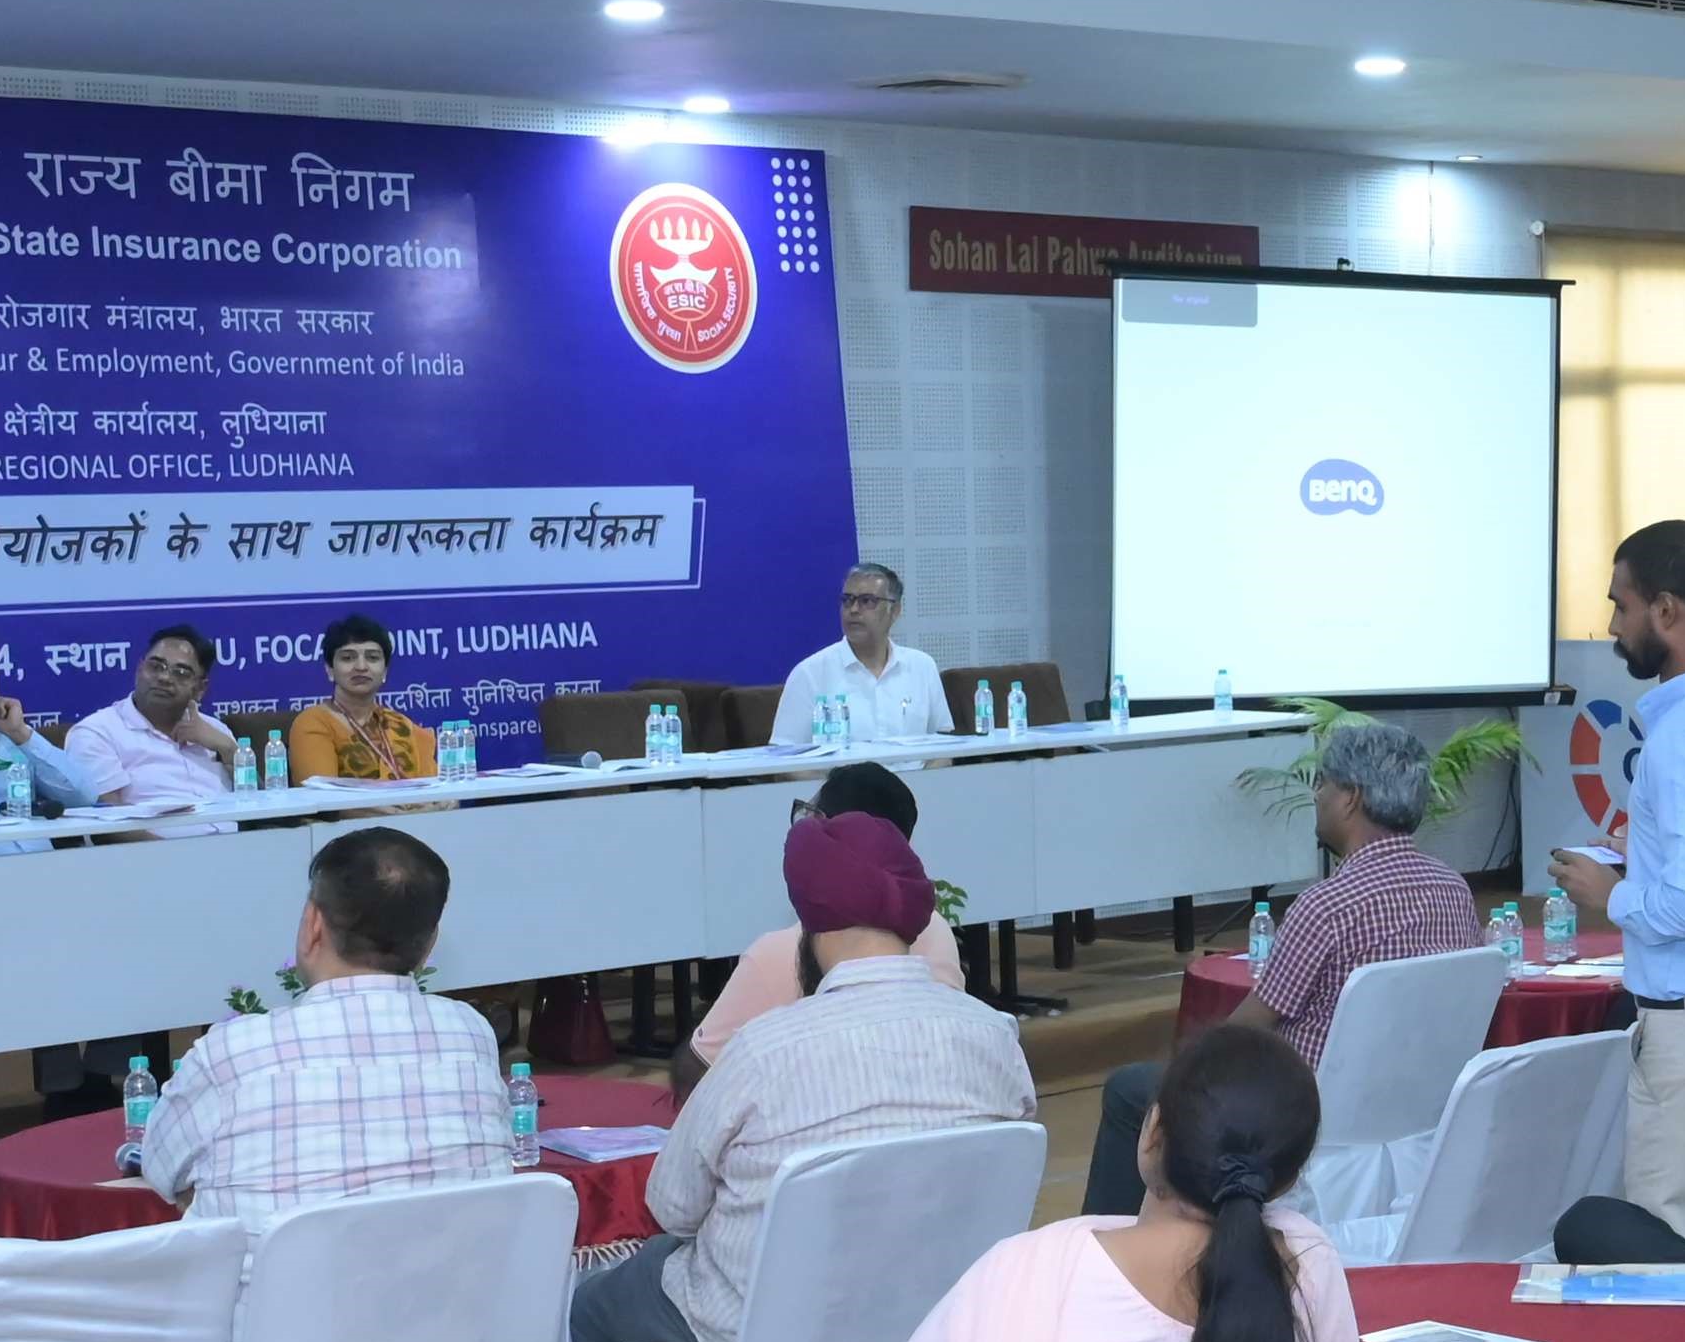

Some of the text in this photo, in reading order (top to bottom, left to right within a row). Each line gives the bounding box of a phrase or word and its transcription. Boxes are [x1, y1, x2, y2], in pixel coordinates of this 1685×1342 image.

[23, 151, 142, 199] राज्य
[166, 147, 267, 205] बीमा
[290, 152, 415, 212] निगम
[91, 225, 262, 263] Insurance
[272, 233, 463, 273] Corporation
[928, 228, 999, 273] Sohan
[1006, 234, 1040, 274] Lal
[105, 295, 205, 335] मंत्रालय,
[219, 305, 284, 335] भारत
[296, 308, 375, 336] सरकार
[667, 293, 707, 309] ESIC
[697, 266, 738, 343] SOCIAL SECURITY
[28, 347, 49, 373] &
[56, 347, 221, 379] Employment,
[228, 350, 377, 377] Government
[382, 351, 407, 376] of
[411, 352, 465, 377] India
[2, 402, 79, 436] क्षेत्रीय
[92, 400, 207, 441] कार्यालय,
[219, 402, 328, 449] लुधियाना
[127, 453, 223, 483] OFFICE,
[228, 452, 355, 478] LUDHIANA
[1309, 479, 1378, 507] BenQ
[165, 511, 210, 560] के
[228, 518, 312, 560] साथ
[327, 513, 512, 557] जागरूकता
[528, 501, 664, 551] कार्यक्रम
[456, 620, 598, 653] LUDHIANA
[43, 641, 131, 676] स्थान
[461, 678, 546, 716] सुनिश्चित
